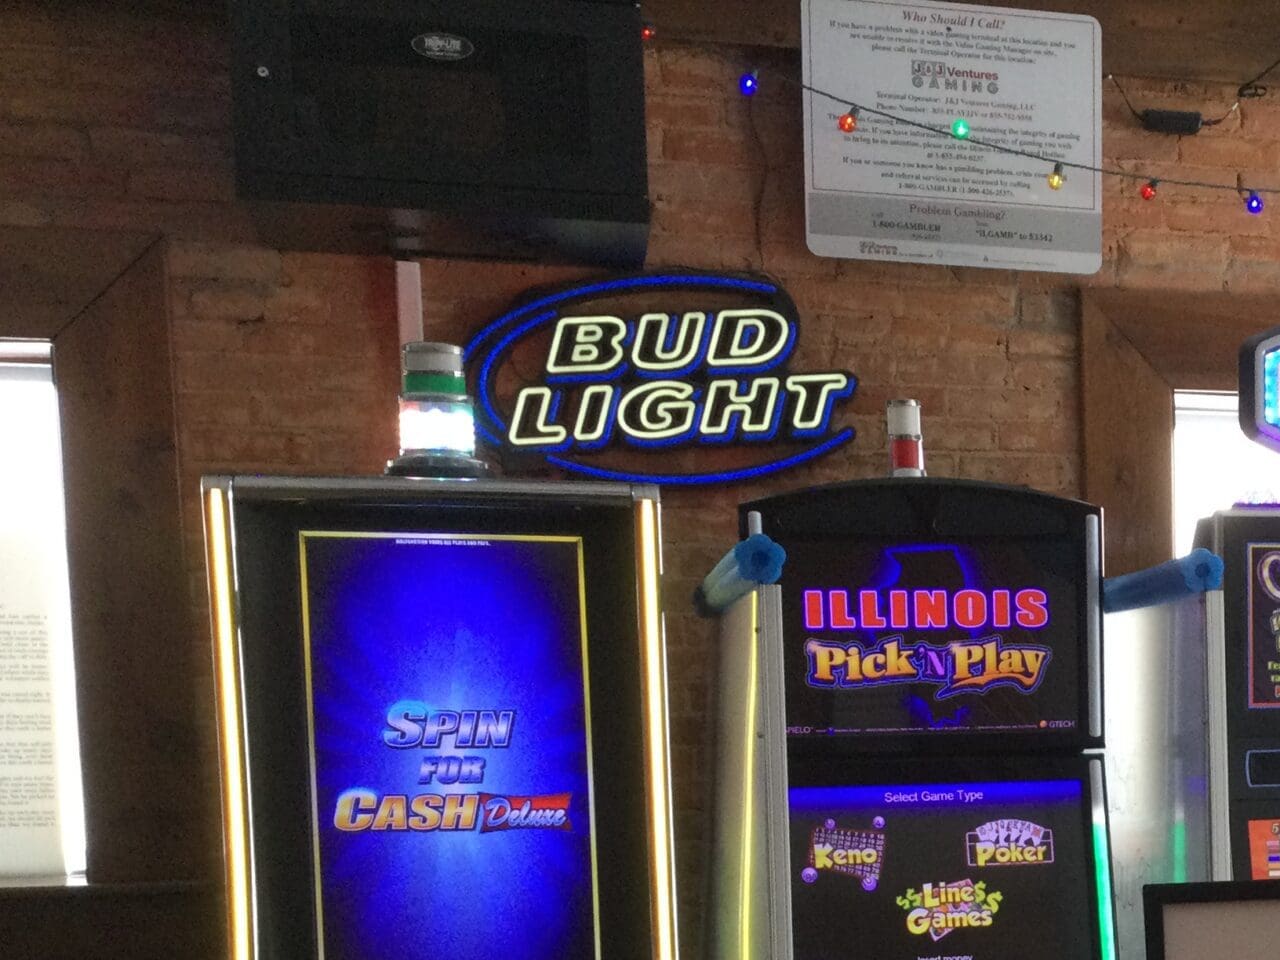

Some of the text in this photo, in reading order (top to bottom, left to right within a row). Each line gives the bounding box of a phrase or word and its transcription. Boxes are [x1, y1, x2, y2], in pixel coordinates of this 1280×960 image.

[902, 10, 1006, 30] Who Should I Call?
[911, 74, 999, 95] GAMING
[947, 66, 999, 81] Ventures
[909, 203, 1006, 221] Problem Gambling?
[546, 309, 790, 373] BUD
[508, 373, 848, 446] LIGHT
[803, 588, 1049, 629] ILLINOIS
[810, 640, 917, 683] Pick
[951, 640, 1049, 692] Play
[383, 700, 514, 748] SPIN
[418, 755, 487, 785] FOR
[334, 788, 568, 832] CASH Deluxe
[884, 788, 984, 804] Select Game Type
[1272, 823, 1279, 834] 5
[814, 842, 878, 869] Keno
[975, 841, 1047, 867] Poker
[906, 907, 993, 936] Games
